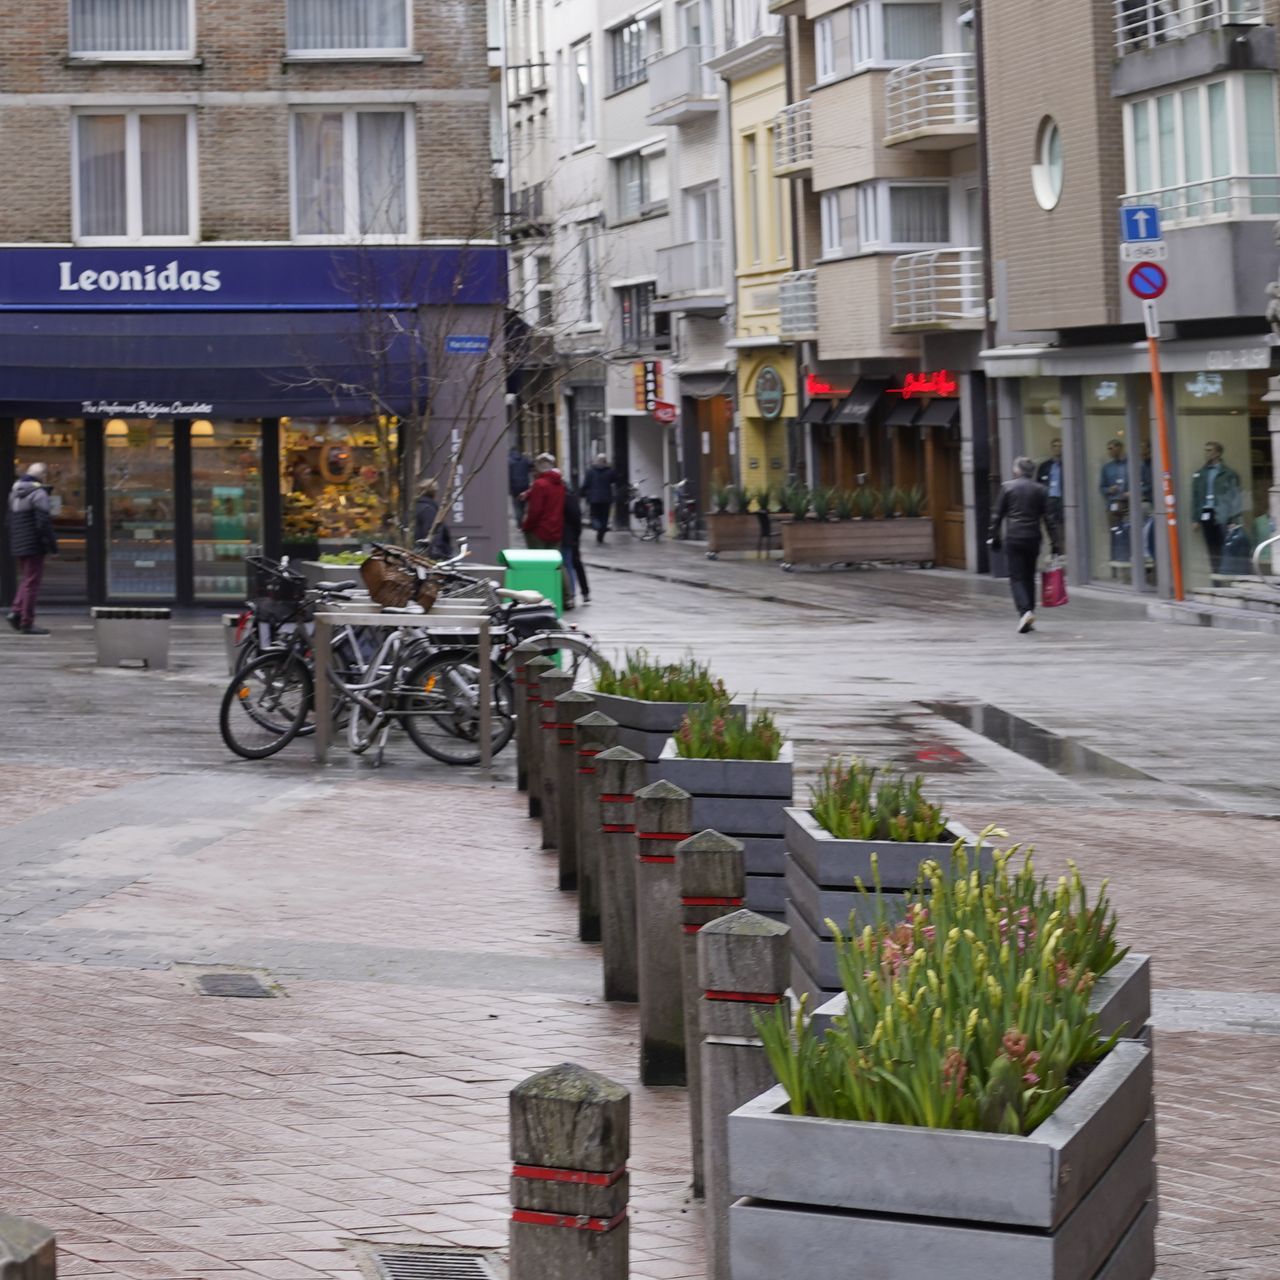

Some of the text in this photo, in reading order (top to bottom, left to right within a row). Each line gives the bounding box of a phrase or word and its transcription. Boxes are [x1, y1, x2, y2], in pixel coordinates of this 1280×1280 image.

[59, 259, 222, 293] Leonidas
[81, 401, 96, 413] The
[138, 401, 169, 418] Belgian
